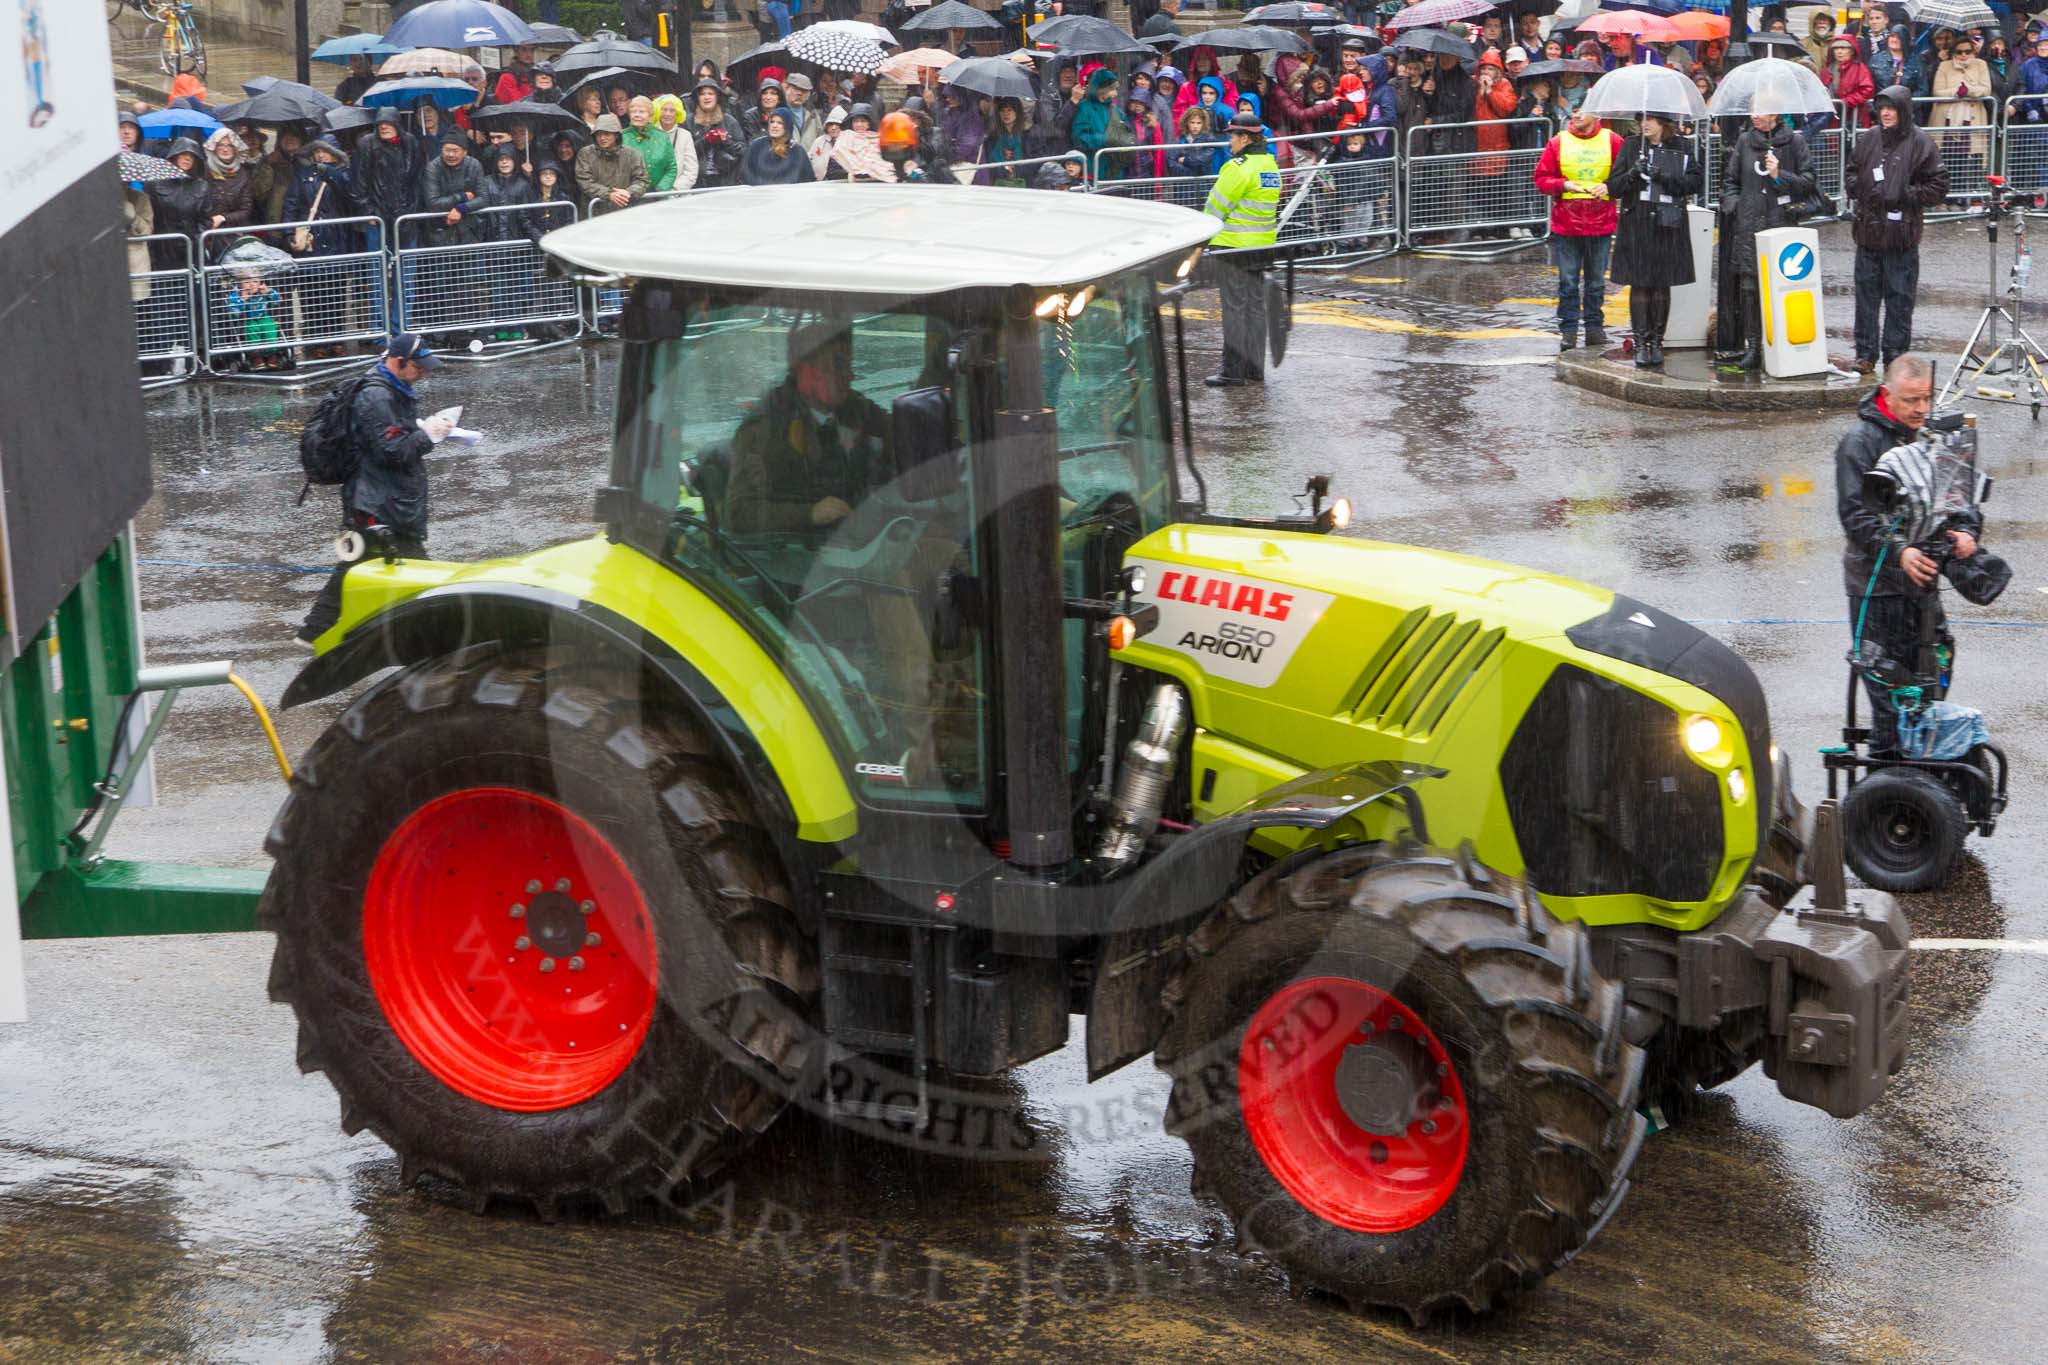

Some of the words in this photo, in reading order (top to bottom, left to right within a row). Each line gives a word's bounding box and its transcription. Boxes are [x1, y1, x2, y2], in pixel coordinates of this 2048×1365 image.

[1156, 571, 1294, 621] CLAAS
[1177, 631, 1263, 663] ARION
[1219, 622, 1276, 648] 650
